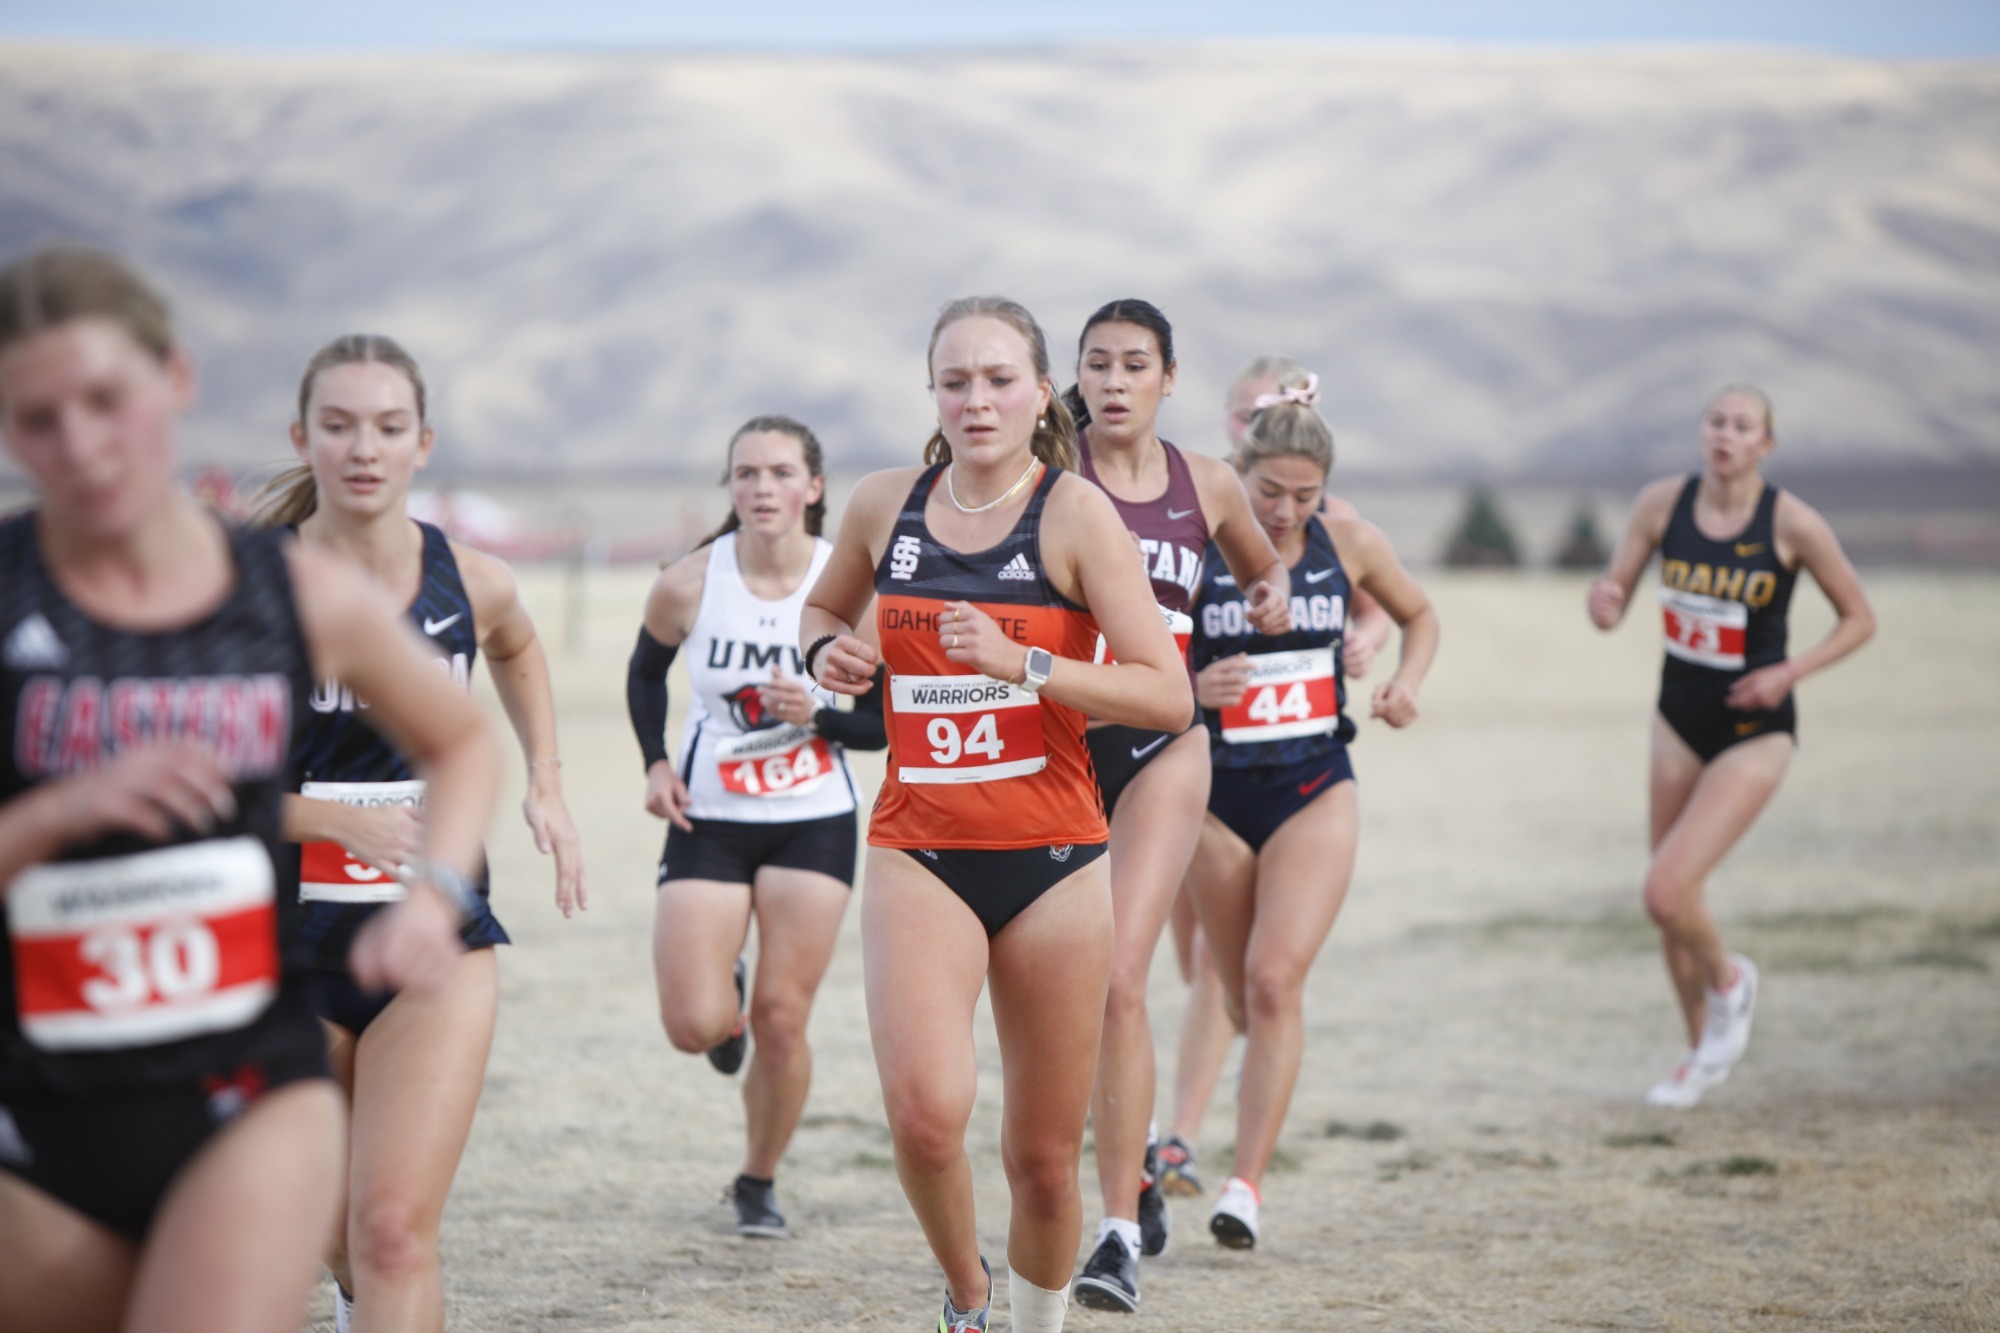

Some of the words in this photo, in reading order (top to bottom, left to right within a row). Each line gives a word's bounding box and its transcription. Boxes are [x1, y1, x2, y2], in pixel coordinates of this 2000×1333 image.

[998, 570, 1035, 581] adidas
[1202, 595, 1344, 638] GOAGA
[912, 685, 1010, 704] WARRIORS
[1248, 680, 1312, 724] 44
[926, 713, 1005, 764] 94
[733, 743, 820, 794] 164
[78, 919, 221, 1011] 30
